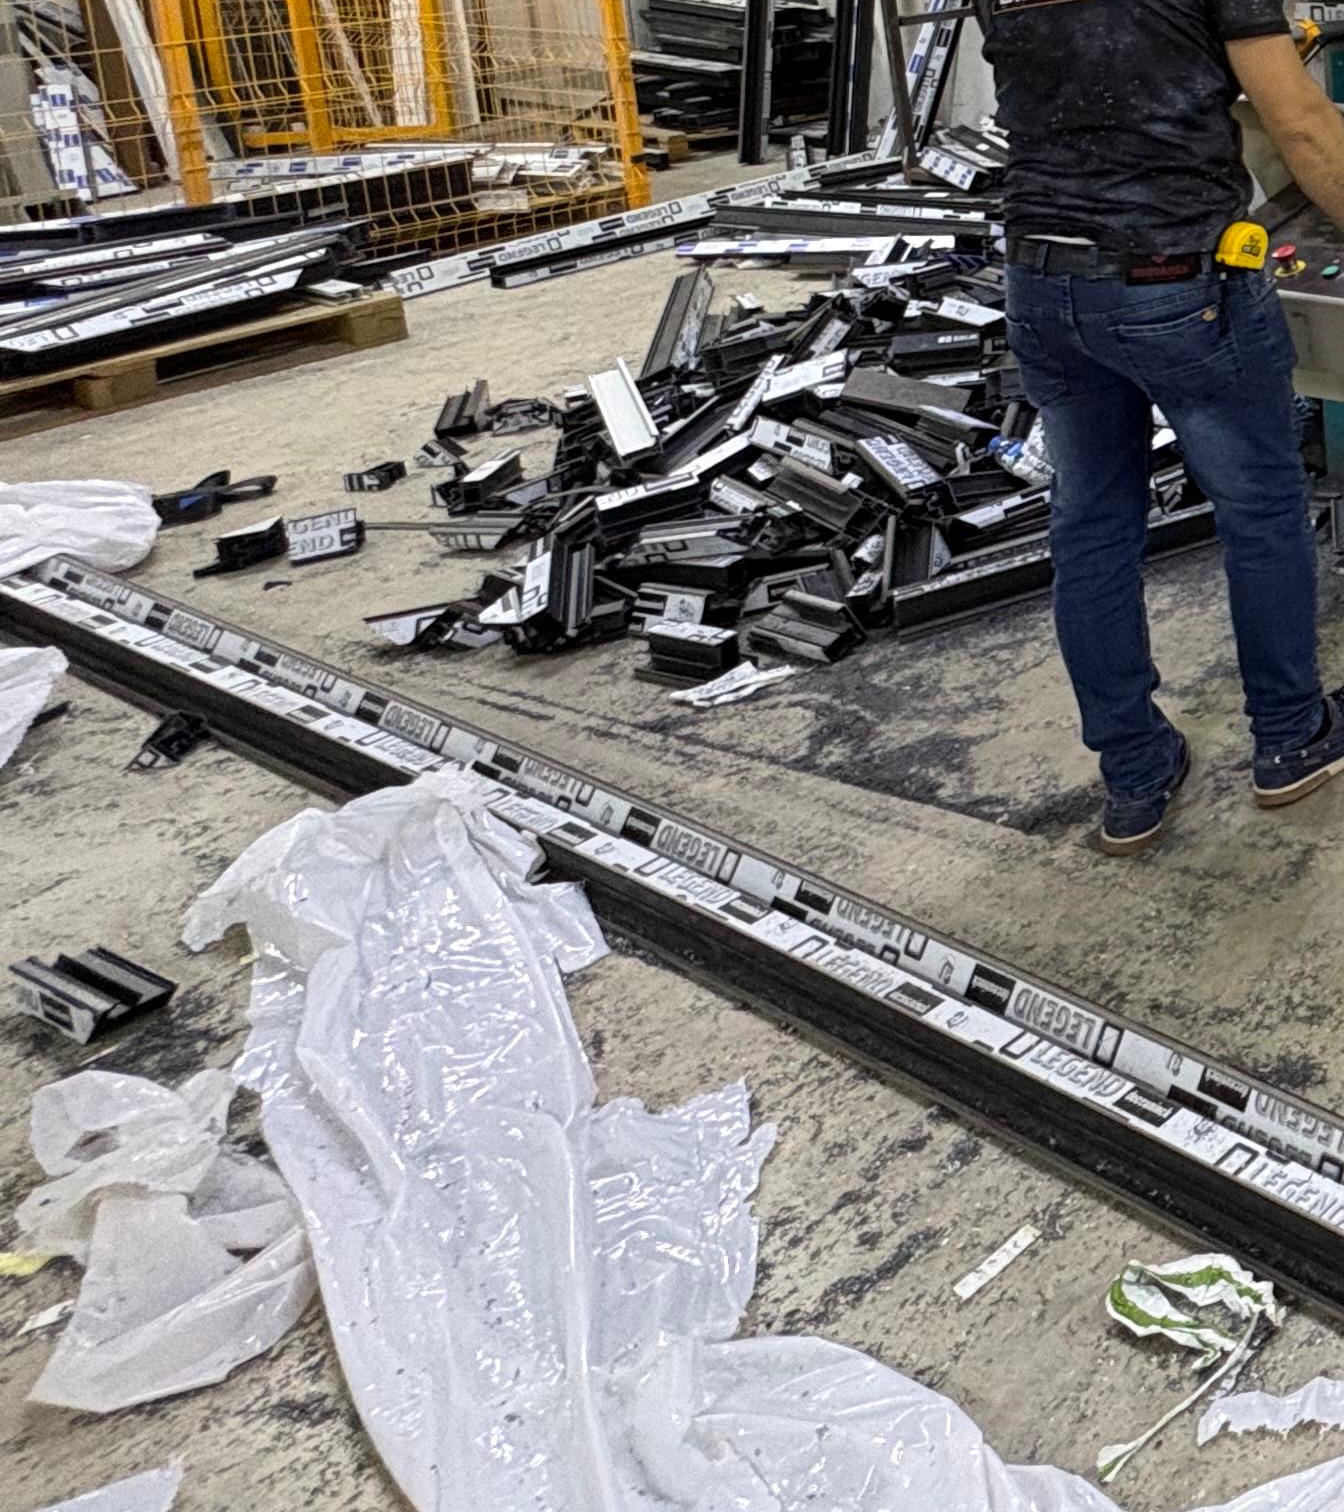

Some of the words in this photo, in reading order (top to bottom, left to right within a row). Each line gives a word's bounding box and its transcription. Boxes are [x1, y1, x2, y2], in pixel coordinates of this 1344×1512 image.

[657, 825, 721, 872] LEGEND
[1013, 987, 1096, 1050] LEGEND
[1031, 1043, 1127, 1098] LEGEND
